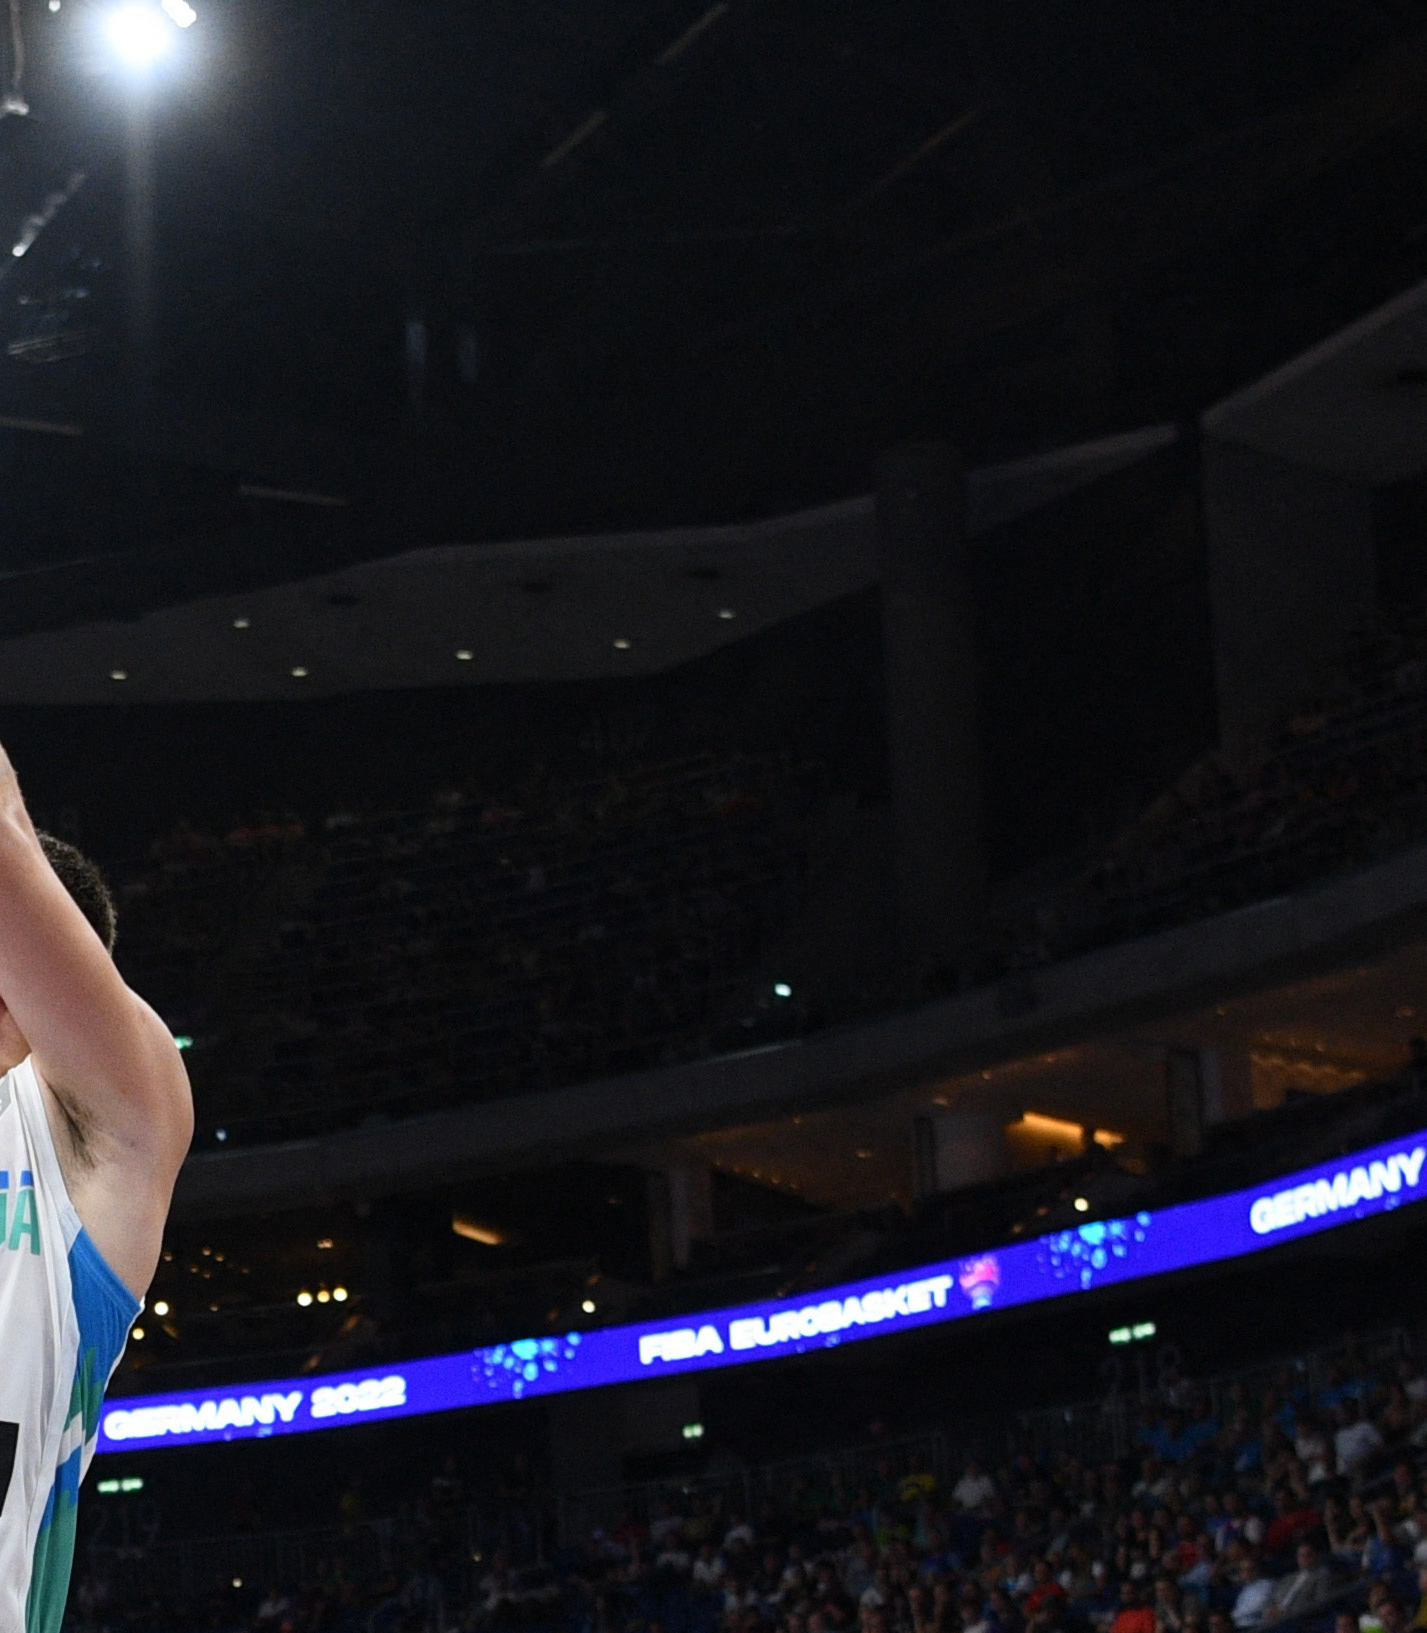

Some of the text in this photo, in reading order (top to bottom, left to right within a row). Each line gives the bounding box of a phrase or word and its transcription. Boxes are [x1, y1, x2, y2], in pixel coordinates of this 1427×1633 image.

[1250, 1147, 1426, 1235] GERMANY
[639, 1274, 954, 1365] FIBA EUROBASKET
[103, 1376, 406, 1440] GERMANY 2022
